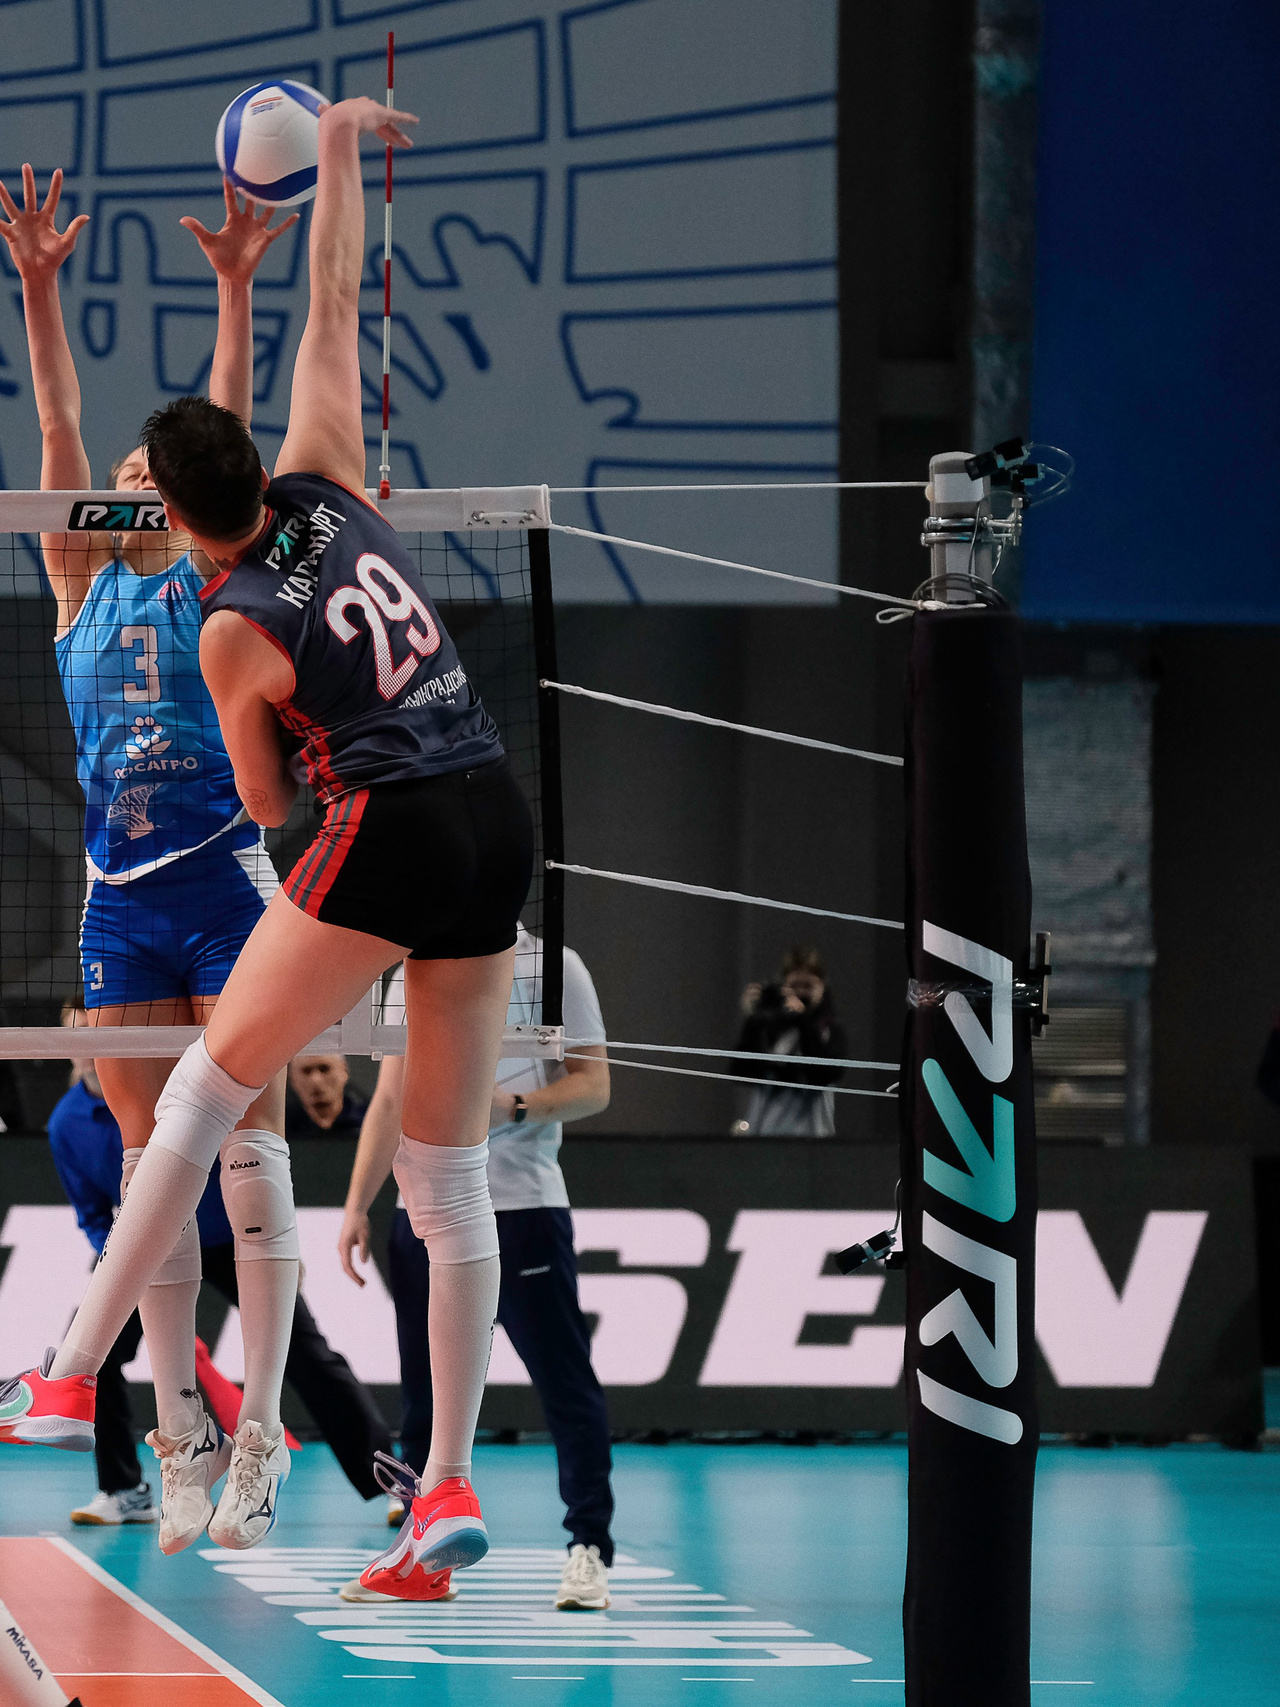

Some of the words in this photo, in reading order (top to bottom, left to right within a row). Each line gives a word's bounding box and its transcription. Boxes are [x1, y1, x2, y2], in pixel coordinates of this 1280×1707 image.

[77, 505, 170, 528] PAR
[265, 511, 308, 571] PARI
[324, 552, 441, 701] 29
[120, 625, 161, 704] 3
[90, 962, 104, 991] 3
[918, 919, 1024, 1445] PARI
